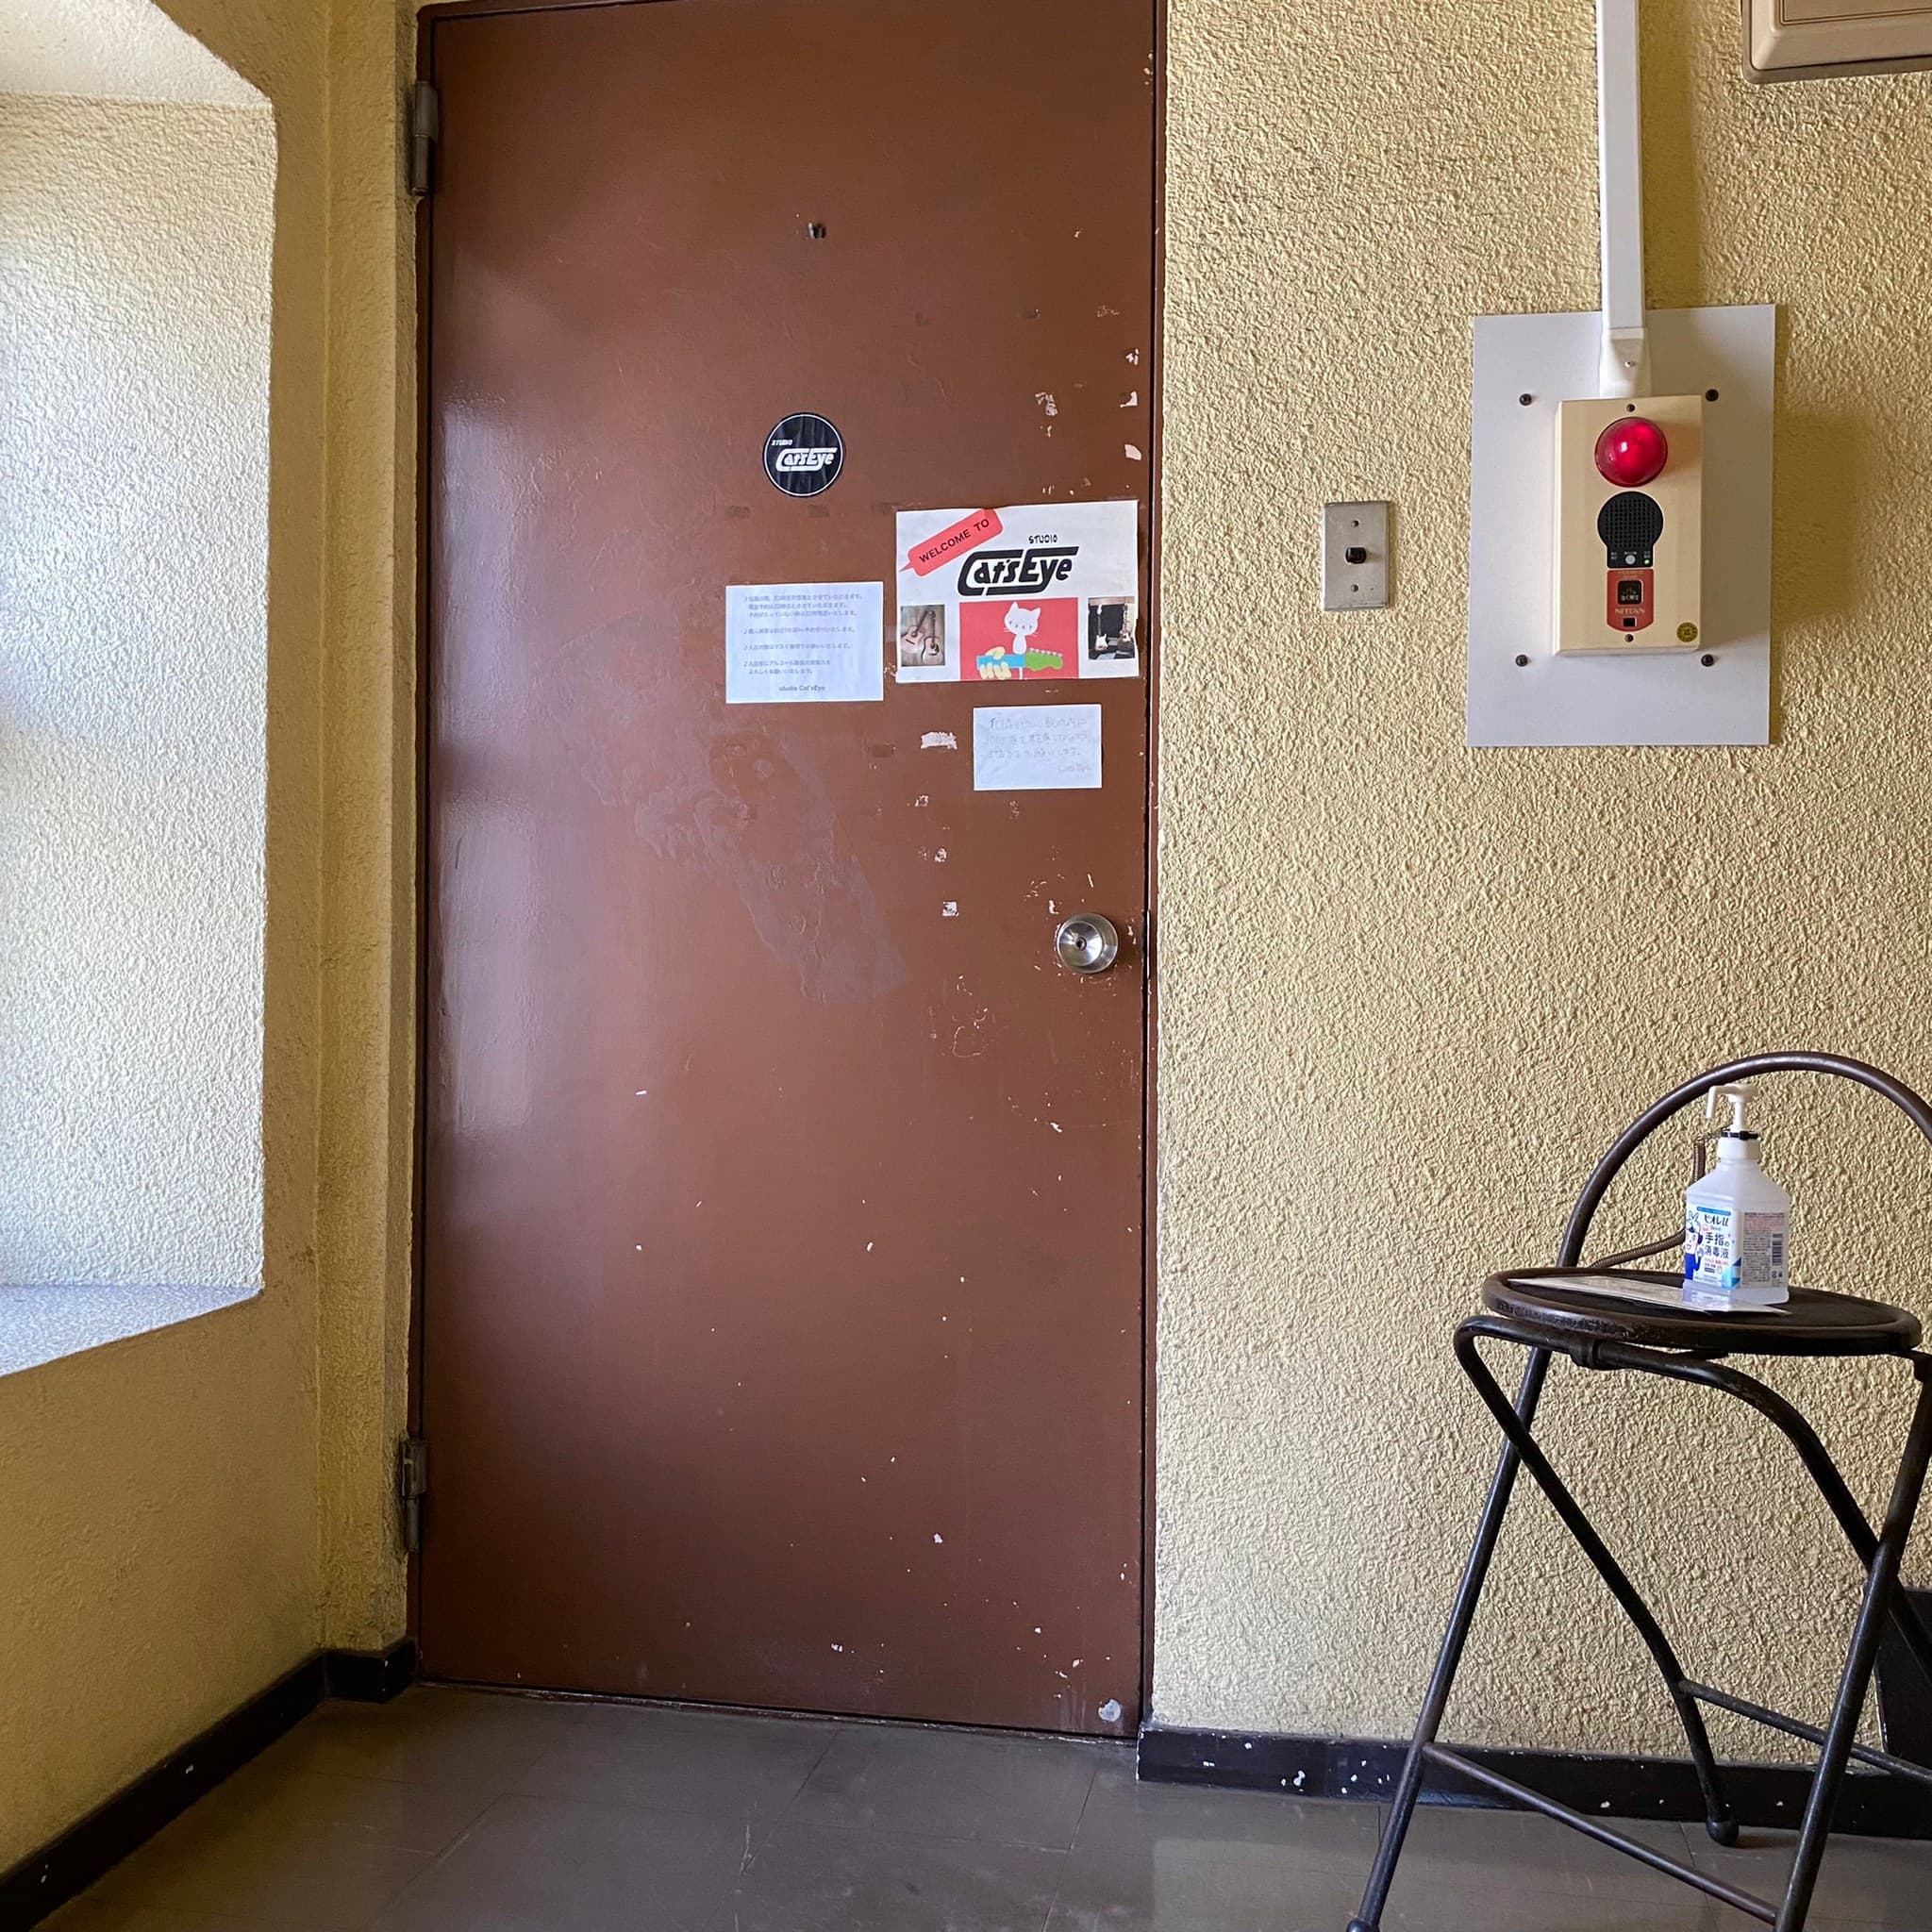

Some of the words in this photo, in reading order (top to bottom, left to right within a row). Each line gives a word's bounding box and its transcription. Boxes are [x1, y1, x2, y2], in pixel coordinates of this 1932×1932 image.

[918, 528, 972, 563] WELCOME
[974, 518, 991, 533] TO
[1028, 533, 1058, 544] STUDIO
